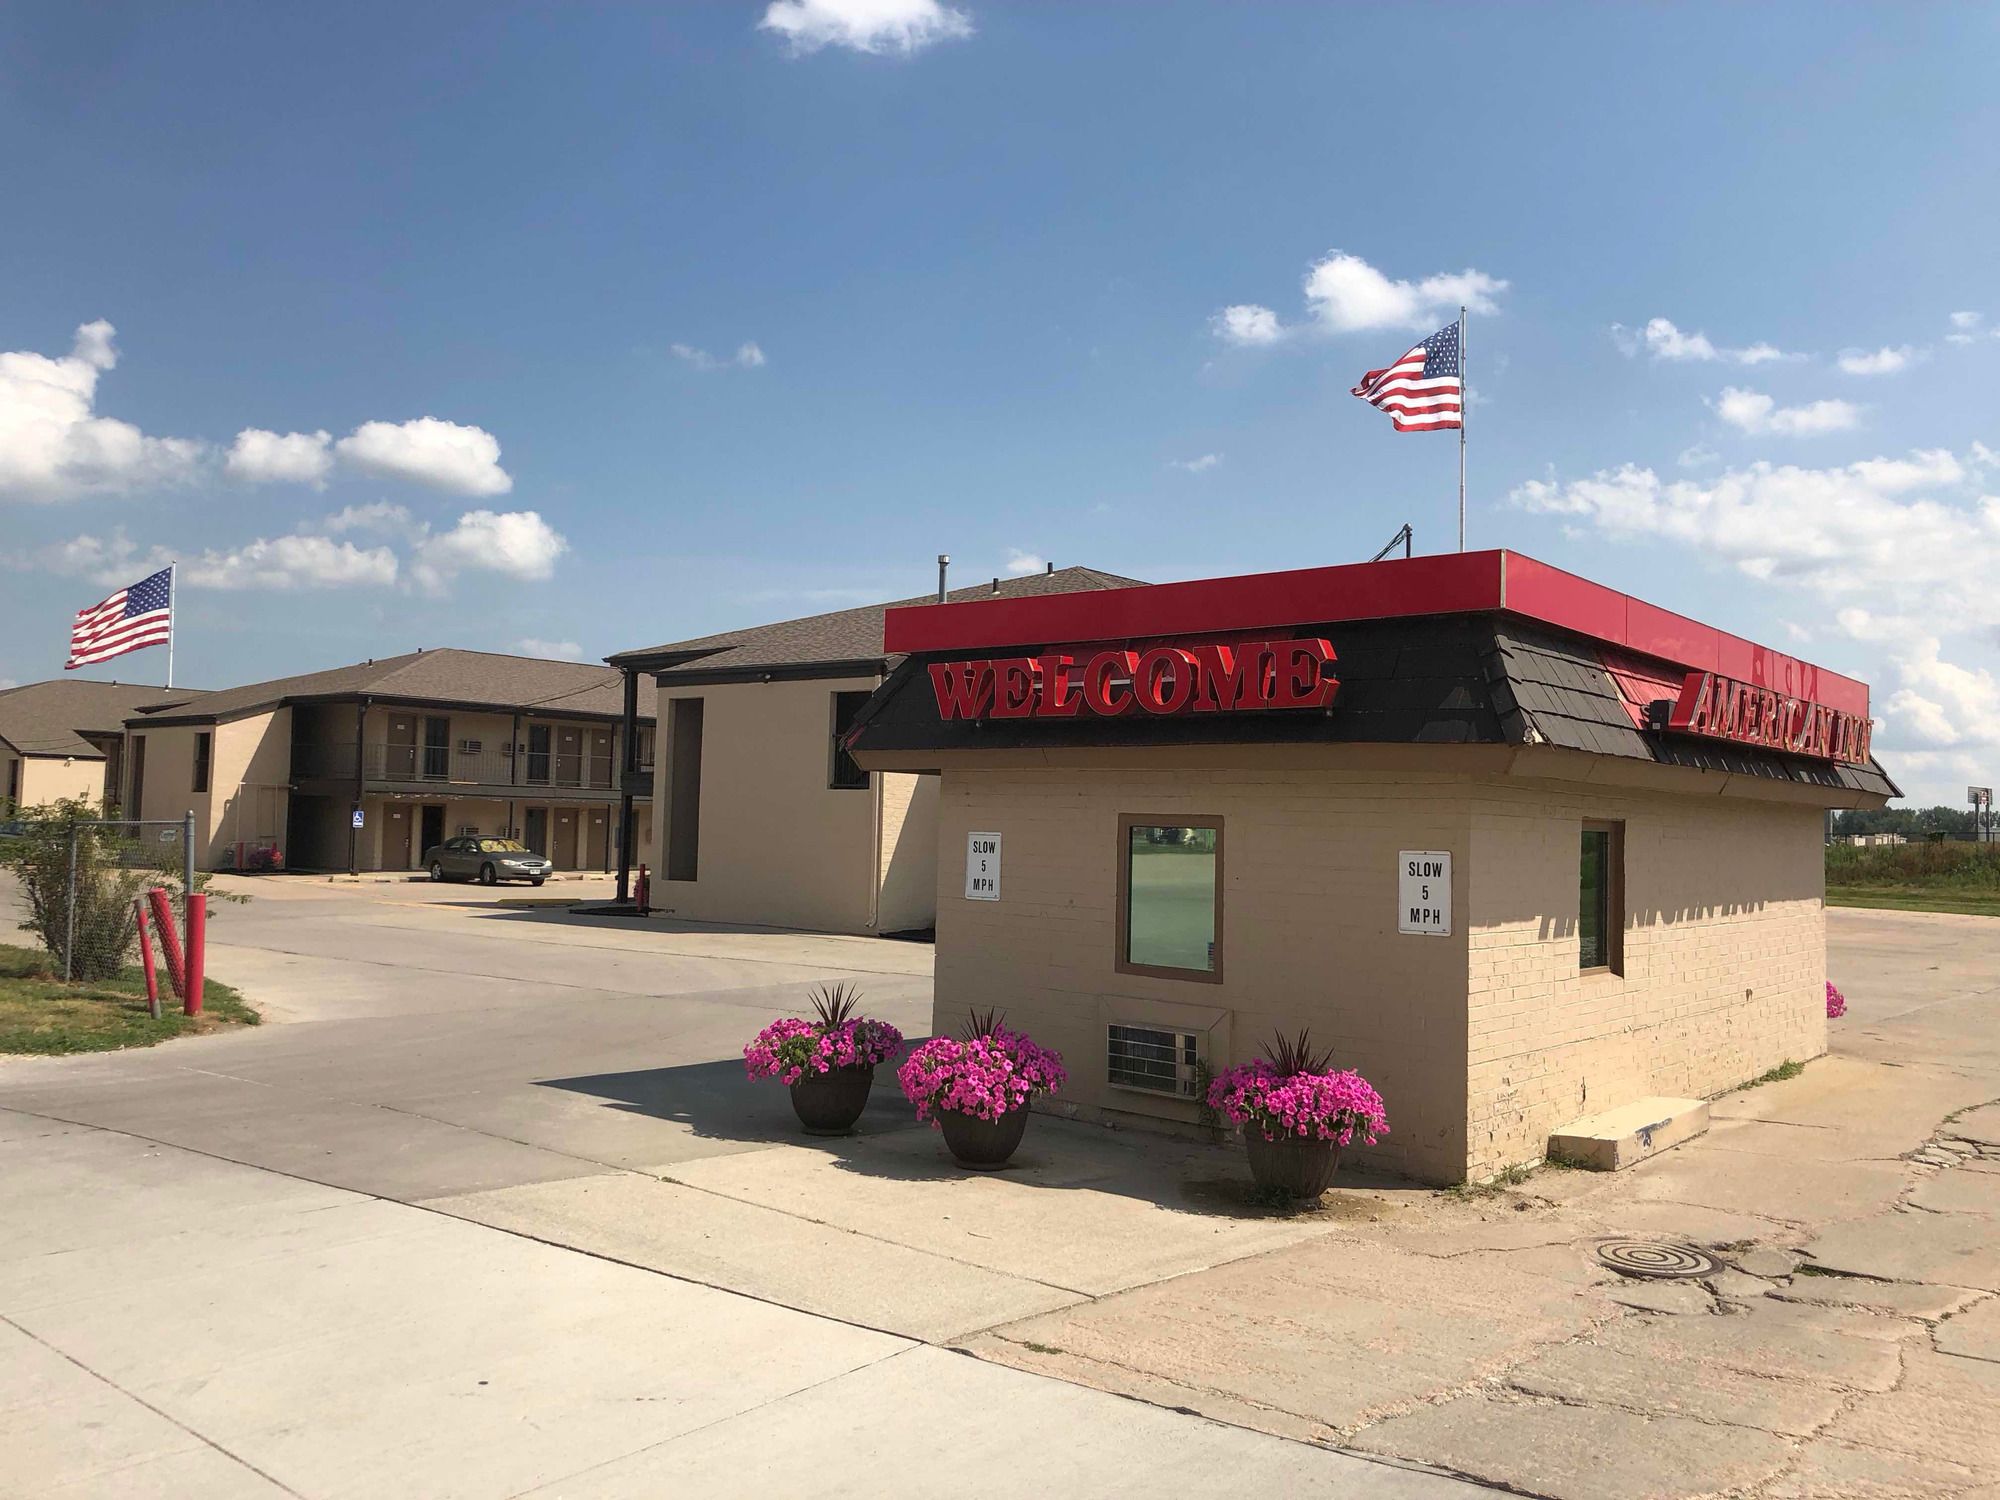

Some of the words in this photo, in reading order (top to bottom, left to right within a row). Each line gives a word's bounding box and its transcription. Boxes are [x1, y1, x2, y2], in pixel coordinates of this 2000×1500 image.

[928, 638, 1340, 720] WELCOME
[1686, 672, 1835, 758] AMERICAN
[1834, 711, 1873, 765] INN
[972, 840, 996, 854] SLOW
[981, 859, 987, 873] 5
[1408, 861, 1443, 878] SLOW
[972, 878, 994, 891] MPH
[1422, 885, 1429, 901] 5
[1410, 908, 1440, 925] MPH
